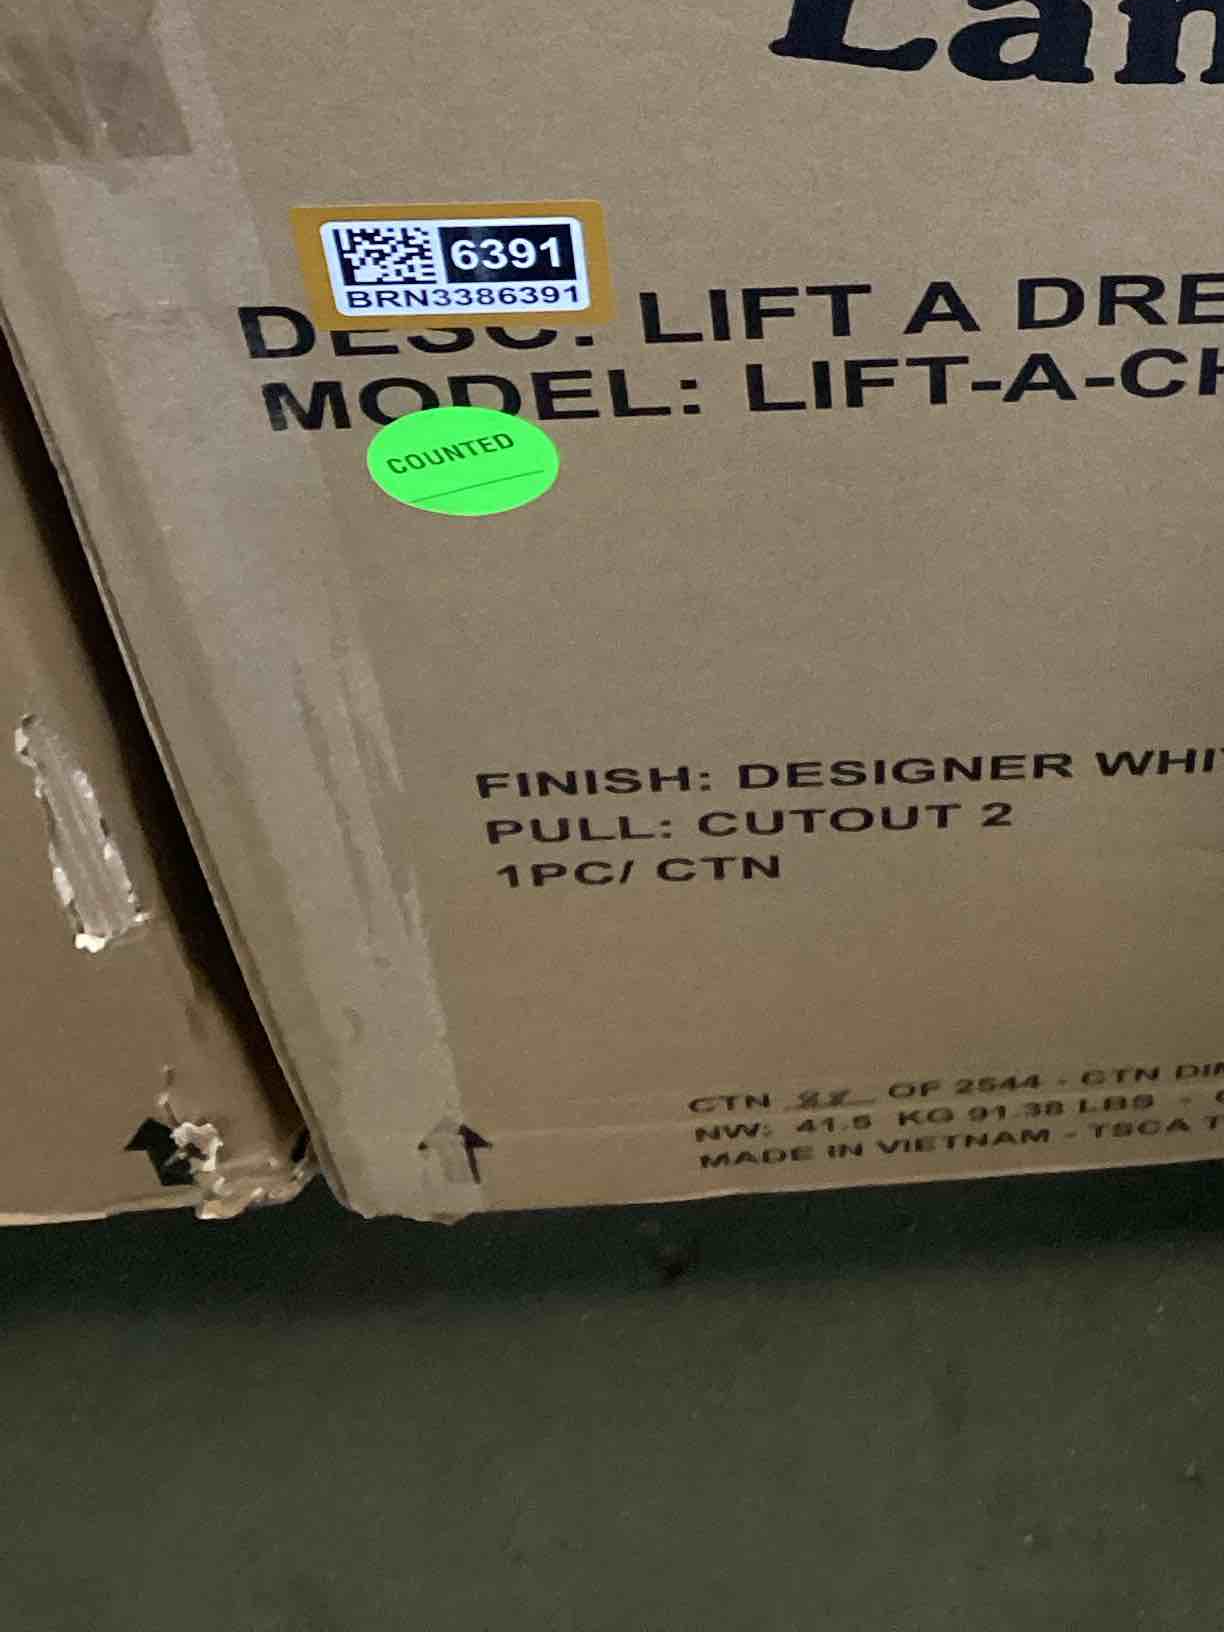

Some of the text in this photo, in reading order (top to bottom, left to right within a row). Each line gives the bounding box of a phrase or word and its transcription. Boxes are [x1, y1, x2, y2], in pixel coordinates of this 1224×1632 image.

[450, 236, 562, 270] 6391
[346, 285, 579, 309] BRN3386391
[640, 285, 871, 344] LIFT
[903, 280, 981, 334] A
[261, 369, 700, 431] MODEL:
[387, 432, 515, 475] COUNTED
[474, 765, 712, 799] FINISH:
[738, 753, 1075, 791] DESIGNER
[486, 802, 1014, 846] PULL: CUTOUT 2
[496, 855, 783, 889] 1PC/ CTN
[688, 1093, 771, 1113] CTN
[888, 1080, 942, 1100] OF
[955, 1074, 1041, 1095] 2544
[1081, 1065, 1160, 1087] CTN
[695, 1122, 774, 1143] NW:
[899, 1107, 955, 1127] KG
[1078, 1093, 1156, 1115] LBS
[699, 1144, 815, 1169] MADE
[827, 1142, 864, 1159] IN
[877, 1127, 1050, 1155] VIETNAM
[1089, 1116, 1192, 1140] TSCA
